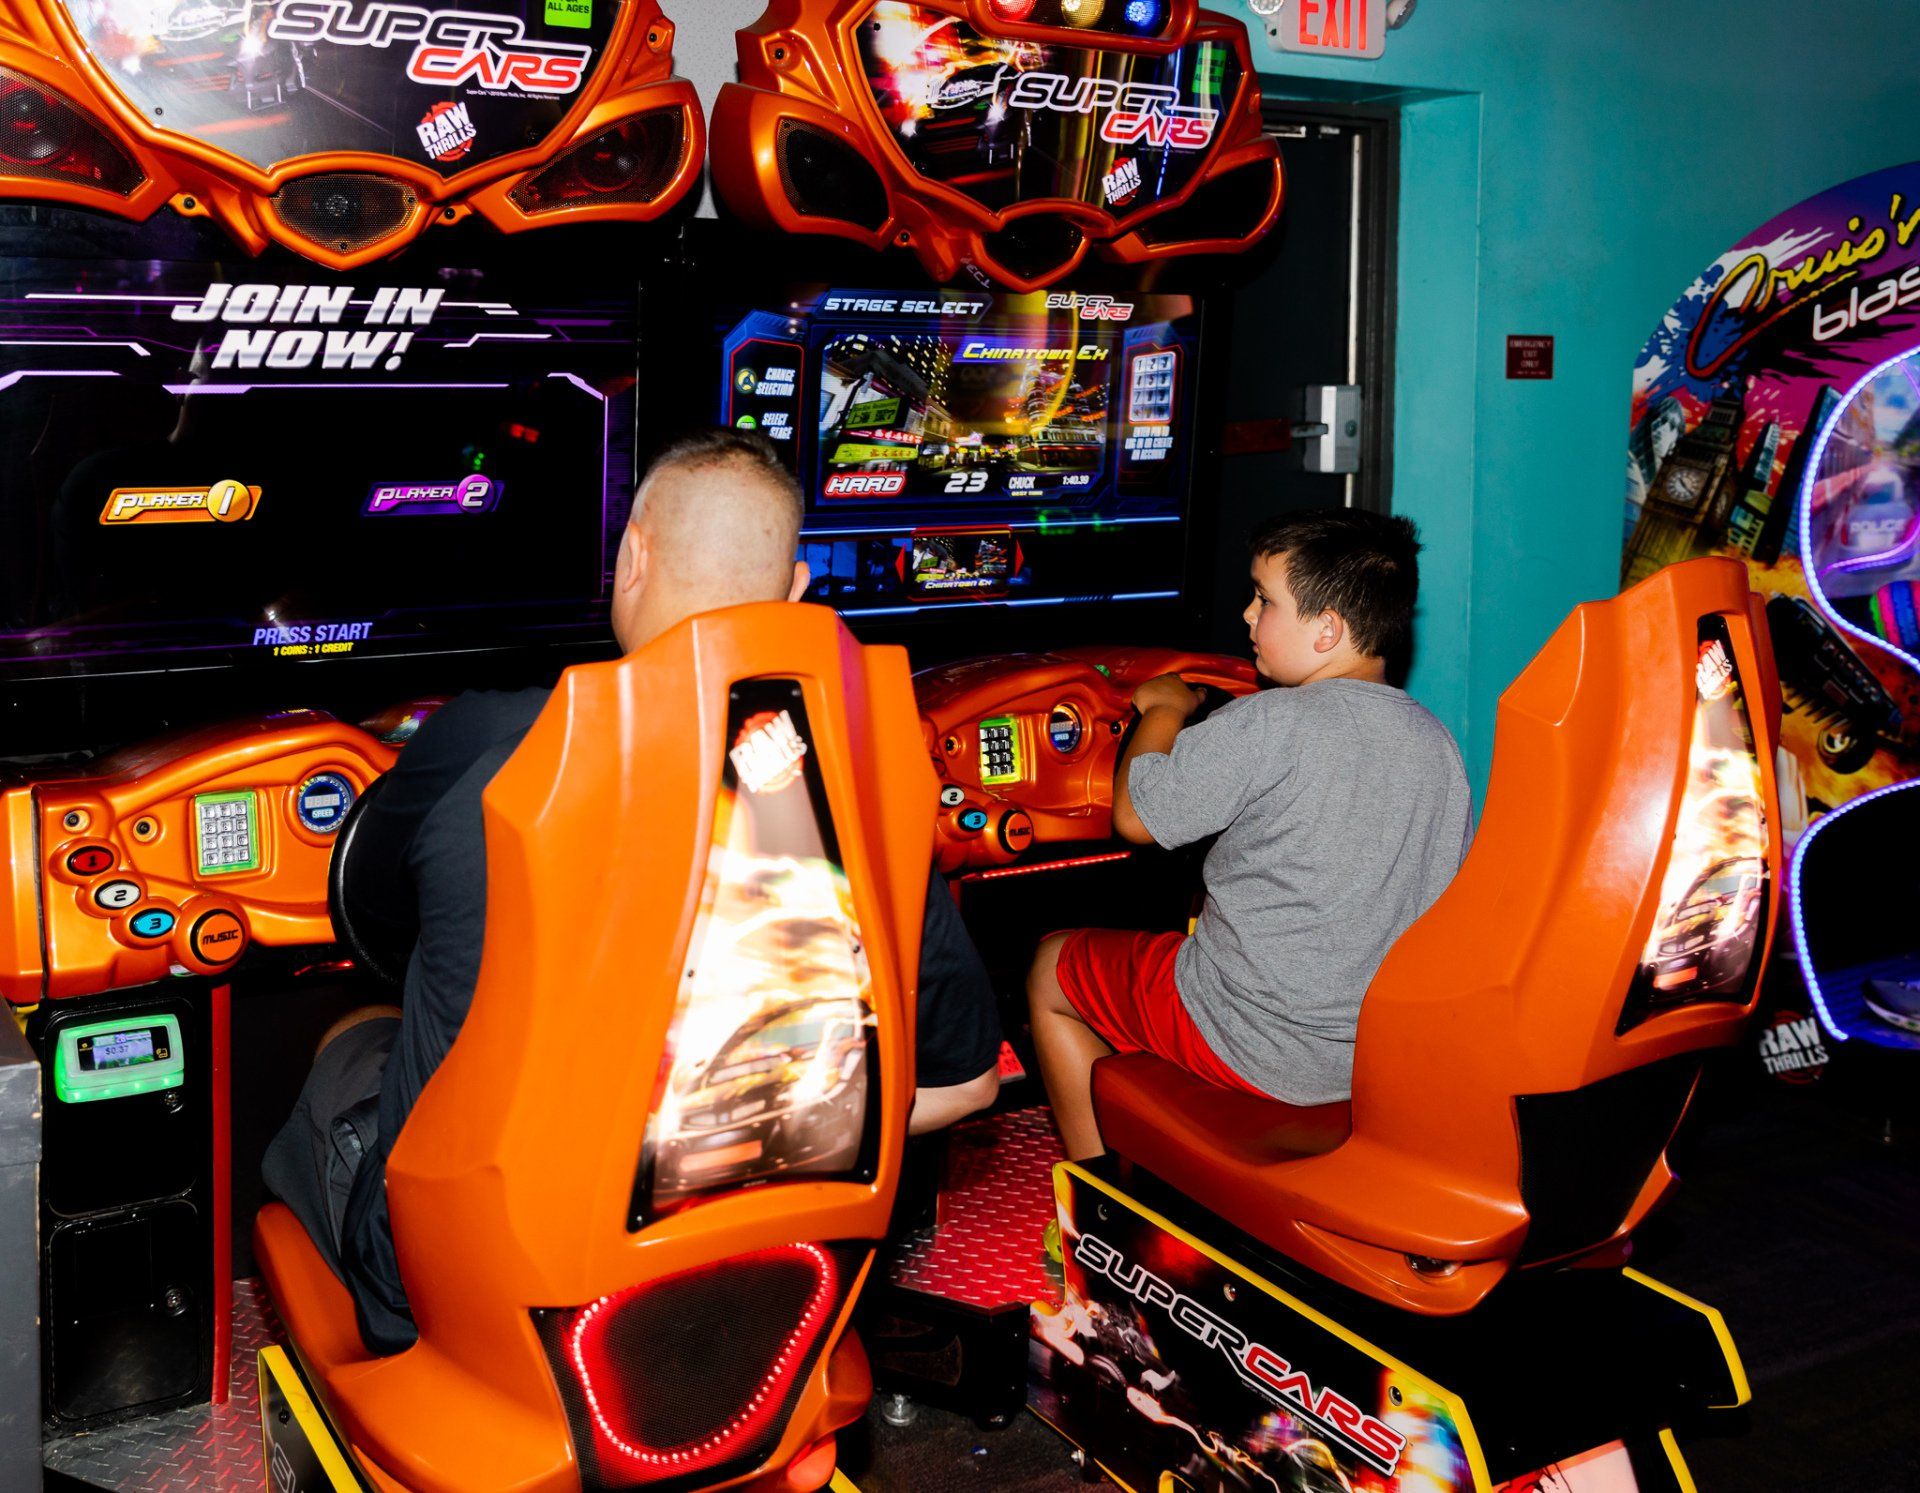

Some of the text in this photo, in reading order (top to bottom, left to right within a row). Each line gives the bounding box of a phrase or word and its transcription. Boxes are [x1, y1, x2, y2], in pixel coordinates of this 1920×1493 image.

[547, 2, 590, 14] ALL AGES
[267, 0, 526, 49] SUPER
[407, 46, 590, 94] CARS
[1009, 72, 1180, 114] SUPER
[416, 102, 470, 146] RAW
[1100, 110, 1219, 149] CARS
[425, 123, 477, 160] THRILLS
[1102, 157, 1139, 193] RAW
[1106, 174, 1142, 205] THRILLS
[171, 283, 446, 324] JOIN IN
[824, 298, 984, 315] STAGE SELECT
[1045, 293, 1113, 308] SUPER
[1813, 266, 1920, 341] blas
[1080, 304, 1134, 322] CARS
[211, 329, 415, 372] NOW!
[765, 367, 796, 382] CHANGE
[755, 381, 795, 396] SELECTION
[762, 412, 789, 426] SELECT
[769, 426, 793, 440] STAGE
[826, 477, 904, 494] HARD
[944, 471, 989, 493] 23
[1008, 476, 1036, 490] CHUCK
[114, 487, 236, 516] PLAYER 1
[375, 481, 489, 507] PLAYER 2
[253, 622, 373, 645] PRESS START
[273, 647, 279, 656] 1
[281, 645, 308, 656] COINS
[315, 644, 320, 653] 1
[321, 642, 354, 653] CREDIT
[950, 792, 957, 801] 2
[313, 809, 334, 818] SPEED
[974, 815, 981, 825] 3
[88, 856, 97, 867] 1
[114, 890, 127, 901] 2
[150, 917, 162, 930] 3
[202, 929, 239, 945] MUSIC
[1760, 1017, 1820, 1056] RAW
[1763, 1044, 1830, 1074] THRILLS
